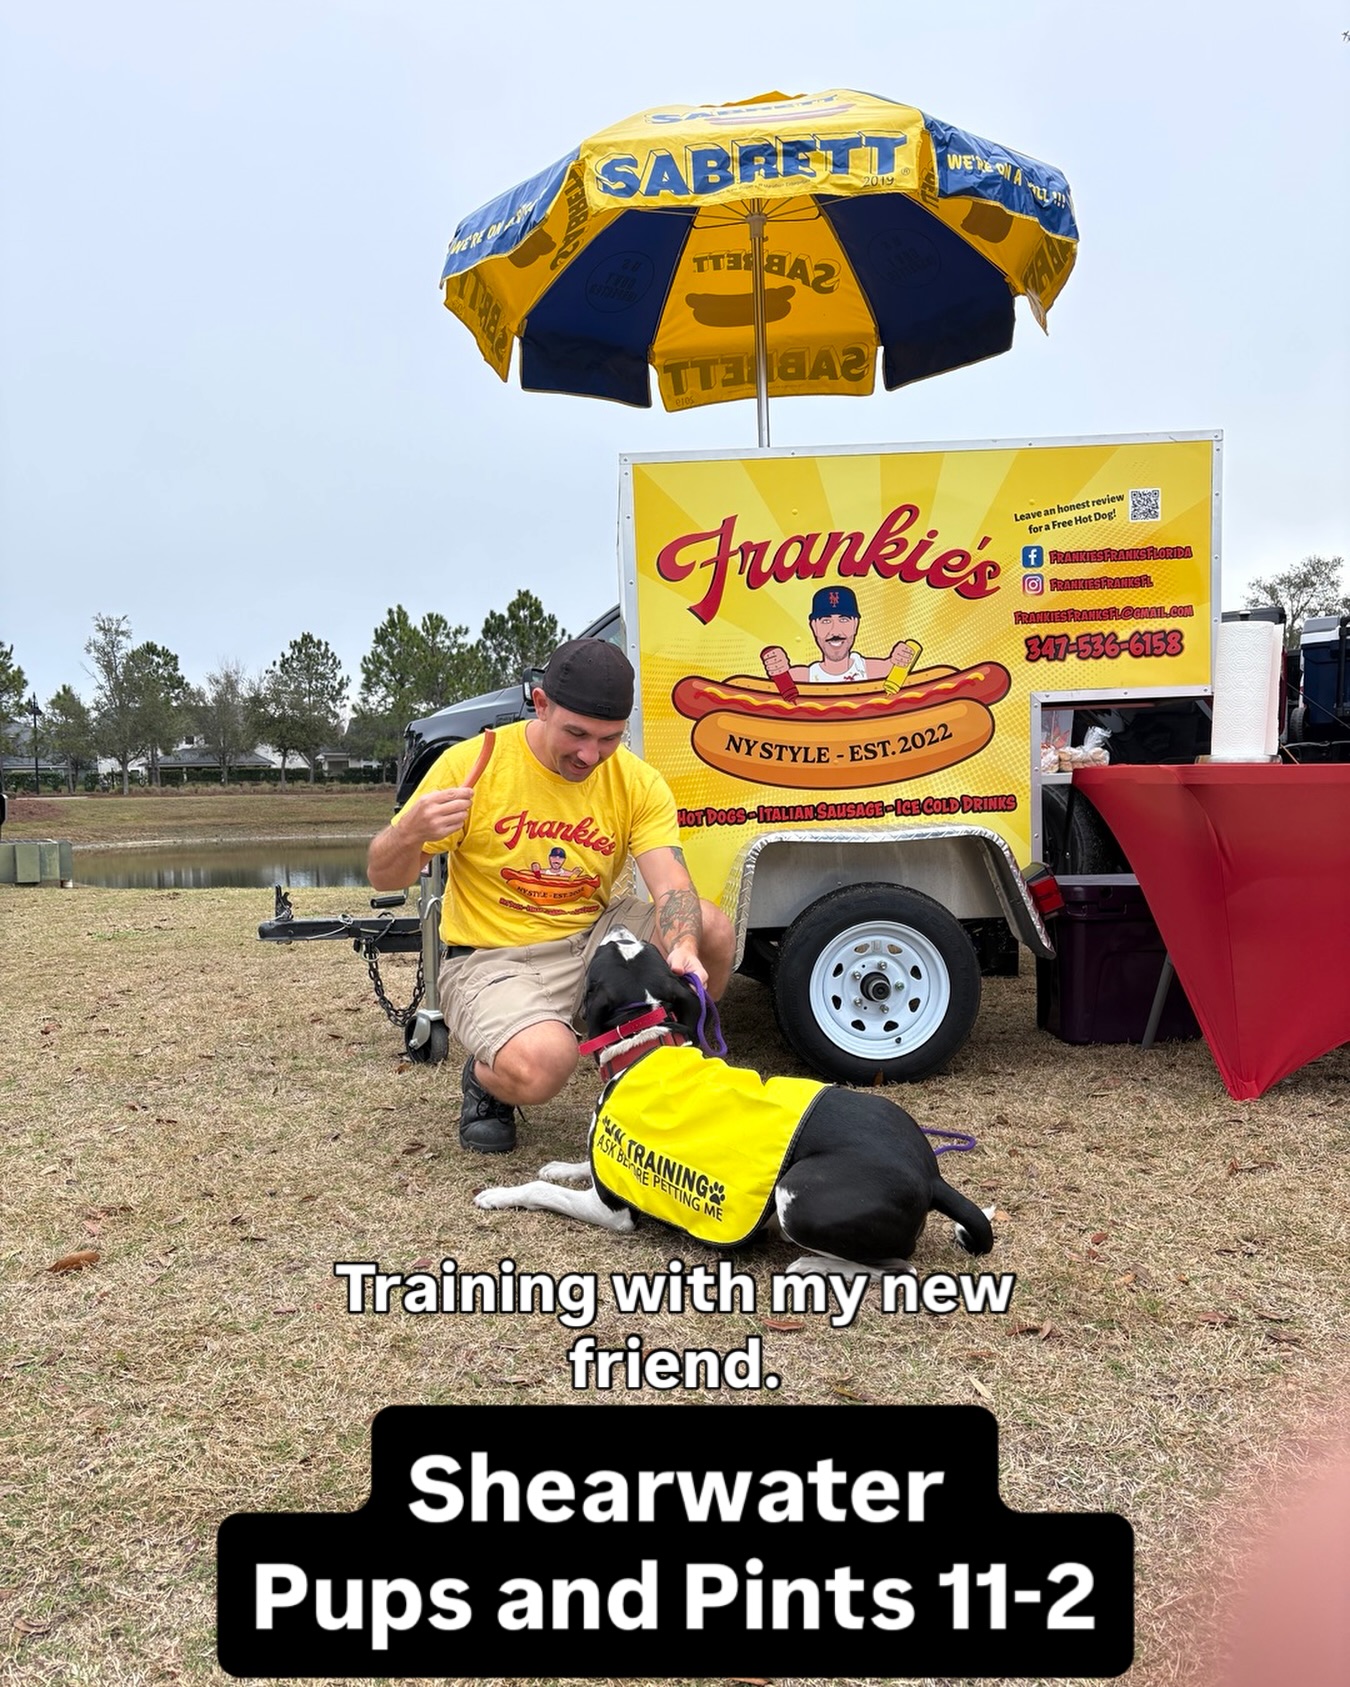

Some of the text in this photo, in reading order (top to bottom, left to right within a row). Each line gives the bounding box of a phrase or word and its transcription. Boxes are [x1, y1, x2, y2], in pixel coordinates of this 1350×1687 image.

[595, 130, 908, 198] SABRETT
[863, 175, 895, 188] 2019
[946, 153, 994, 174] WE'RE
[1013, 168, 1023, 187] A
[1013, 494, 1125, 522] Leave an honest review
[1028, 508, 1117, 534] for a Free Hot Dog!
[657, 503, 1002, 627] Frankie's
[1025, 629, 1184, 662] 347-536-6158
[725, 734, 758, 757] NY
[759, 742, 830, 764] STYLE
[849, 740, 897, 762] EST.
[898, 723, 953, 754] 2022
[494, 810, 617, 856] Frankie's
[597, 1134, 617, 1160] ASK
[652, 1175, 702, 1212] PETTING
[703, 1202, 723, 1222] ME
[627, 1139, 709, 1198] TRAINING
